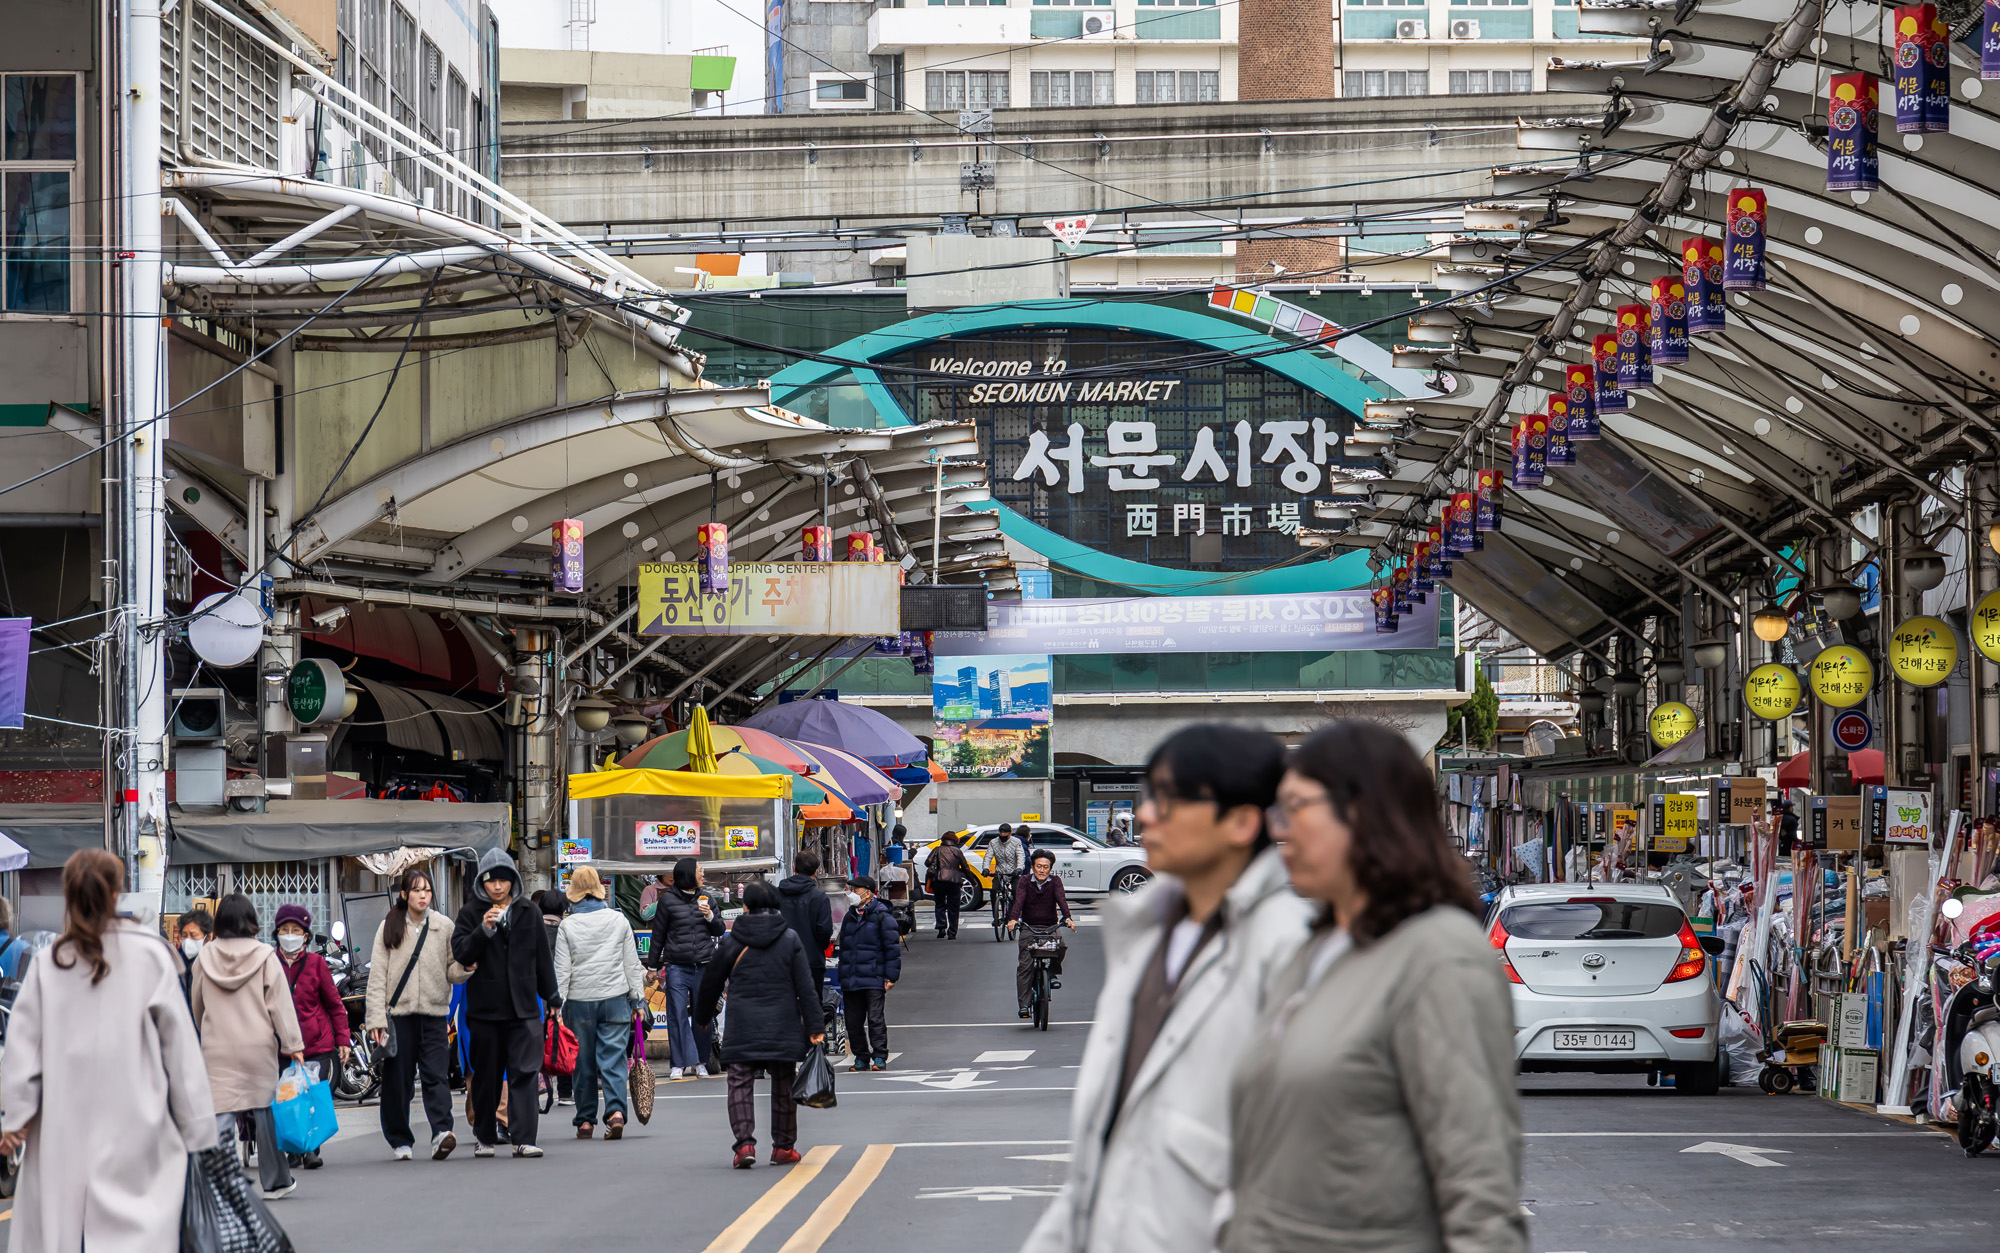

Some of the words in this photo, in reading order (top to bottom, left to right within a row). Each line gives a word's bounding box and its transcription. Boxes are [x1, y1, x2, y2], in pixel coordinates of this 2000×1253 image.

[1898, 77, 1921, 94] 서문
[1931, 79, 1947, 94] 서문
[1898, 95, 1922, 111] 시장
[1833, 138, 1858, 155] 서문
[1833, 156, 1859, 170] 시장
[1055, 219, 1086, 231] 주의
[1734, 243, 1758, 258] 서문
[1733, 259, 1758, 271] 시장
[1687, 291, 1701, 306] 서문
[1710, 292, 1723, 304] 서문
[1688, 305, 1703, 318] 시장
[1669, 327, 1684, 339] 서문
[1620, 352, 1638, 364] 서문
[928, 357, 1032, 376] Welcome
[1042, 356, 1067, 376] to
[1620, 364, 1639, 376] 시장
[968, 382, 1072, 403] SEOMUN
[1076, 379, 1180, 402] MARKET
[1602, 390, 1624, 399] 야시장
[1570, 407, 1587, 418] 서문
[1571, 418, 1588, 428] 시장
[1551, 435, 1566, 446] 서문
[1012, 416, 1340, 494] 서문시장
[1530, 451, 1543, 462] 서문
[1551, 445, 1567, 456] 시장
[1530, 461, 1545, 472] 시장
[1125, 502, 1300, 537] 西門市場
[567, 560, 580, 572] 서문
[645, 564, 700, 574] DONGSA
[727, 563, 772, 574] OPPING
[777, 564, 825, 574] CENTER
[567, 571, 583, 581] 시장
[1978, 608, 2000, 629] 서문
[1895, 633, 1931, 653] 서문시장
[1815, 660, 1847, 678] 서문시장
[1897, 657, 1948, 672] 건해산물
[1750, 677, 1779, 693] 서문시장
[1819, 682, 1864, 695] 건해산물
[292, 698, 321, 710] 동산상가
[1752, 696, 1793, 708] 건해산물
[1841, 726, 1865, 735] 소화전
[980, 765, 1008, 774] DTRO
[1669, 800, 1683, 812] 강남
[1684, 801, 1694, 811] 99
[1733, 797, 1763, 807] 화분류
[1898, 806, 1922, 823] 찹쌀
[1667, 819, 1695, 831] 수제피자
[1832, 819, 1844, 830] 커
[1889, 825, 1928, 840] 꽈배기
[1077, 870, 1083, 878] T
[1562, 1034, 1587, 1046] 35부
[1594, 1034, 1627, 1046] 0144
